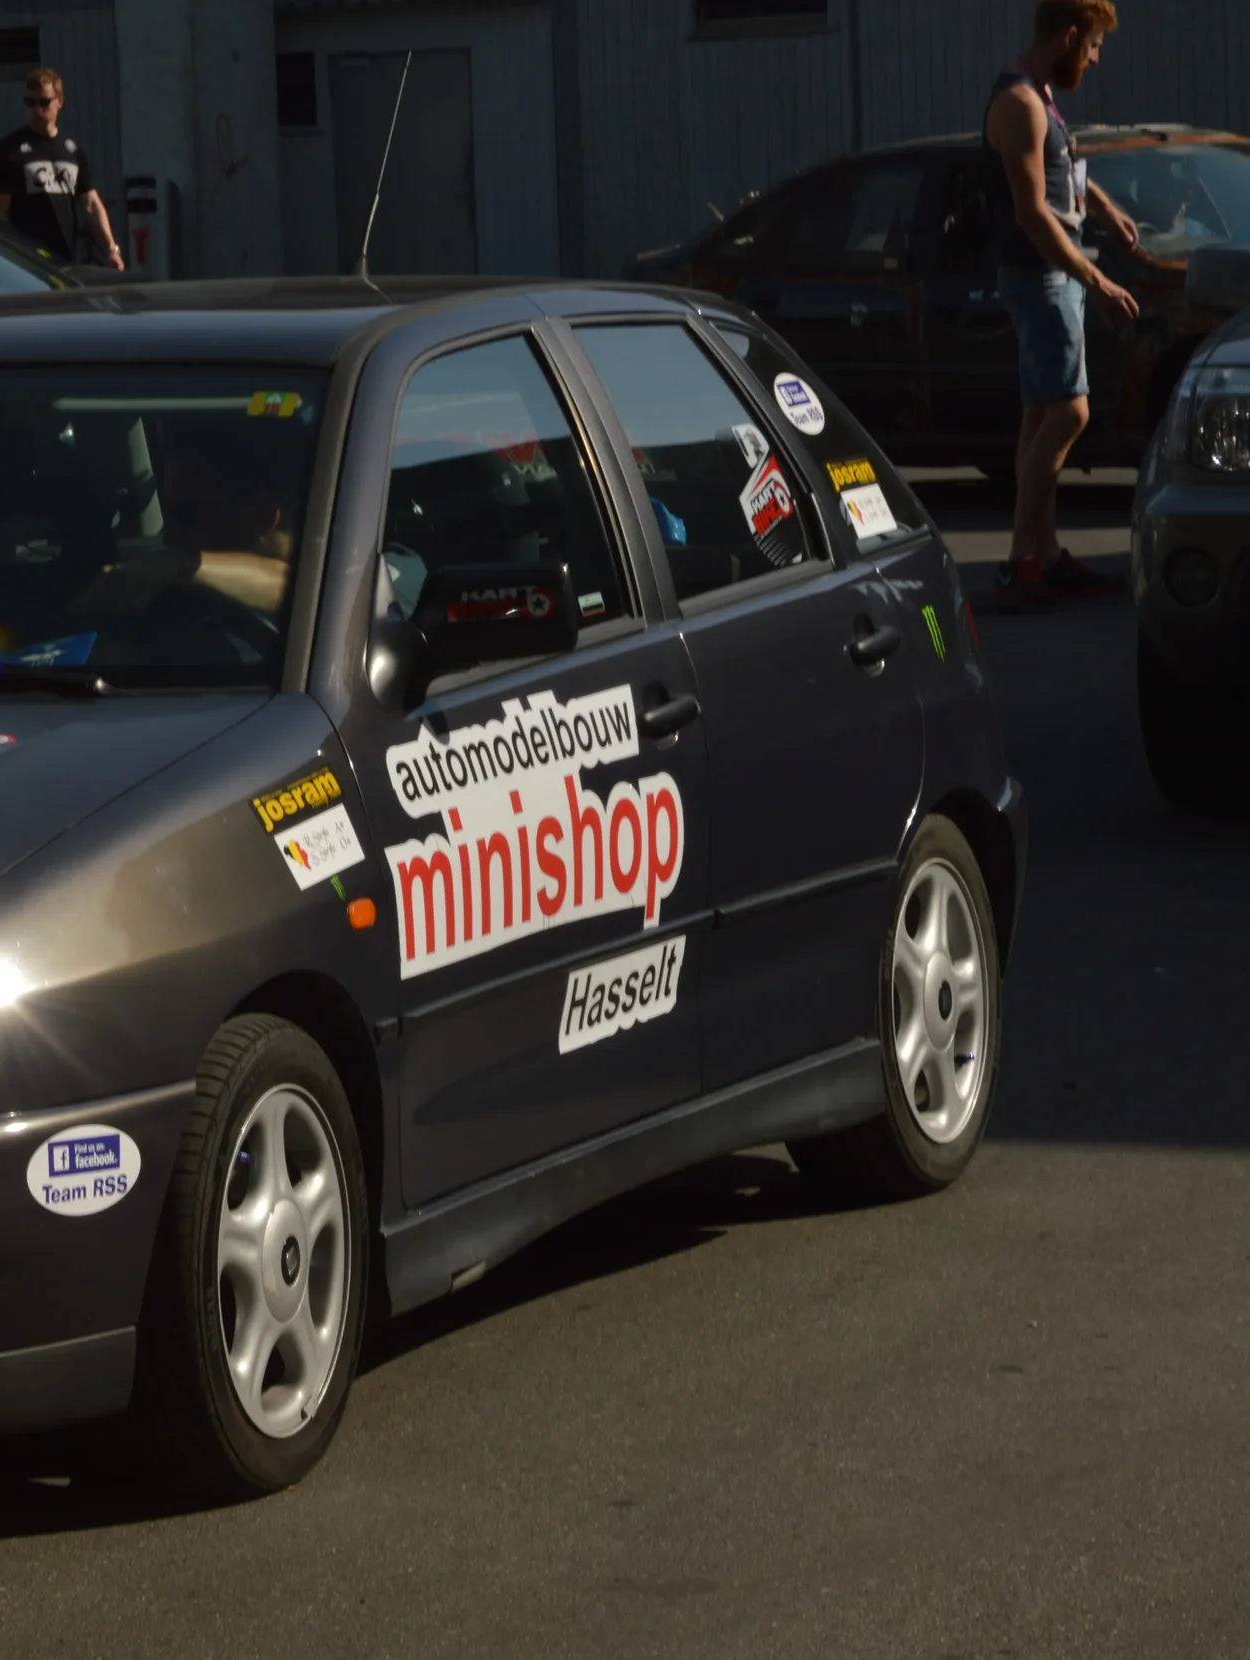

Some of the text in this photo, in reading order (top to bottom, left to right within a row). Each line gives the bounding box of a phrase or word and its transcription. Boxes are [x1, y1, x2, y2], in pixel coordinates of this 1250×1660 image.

[395, 700, 633, 802] automodelbouw
[253, 771, 343, 833] josram
[396, 775, 679, 962] minishop
[565, 943, 679, 1036] Hasselt
[42, 1174, 128, 1205] Team RSS
